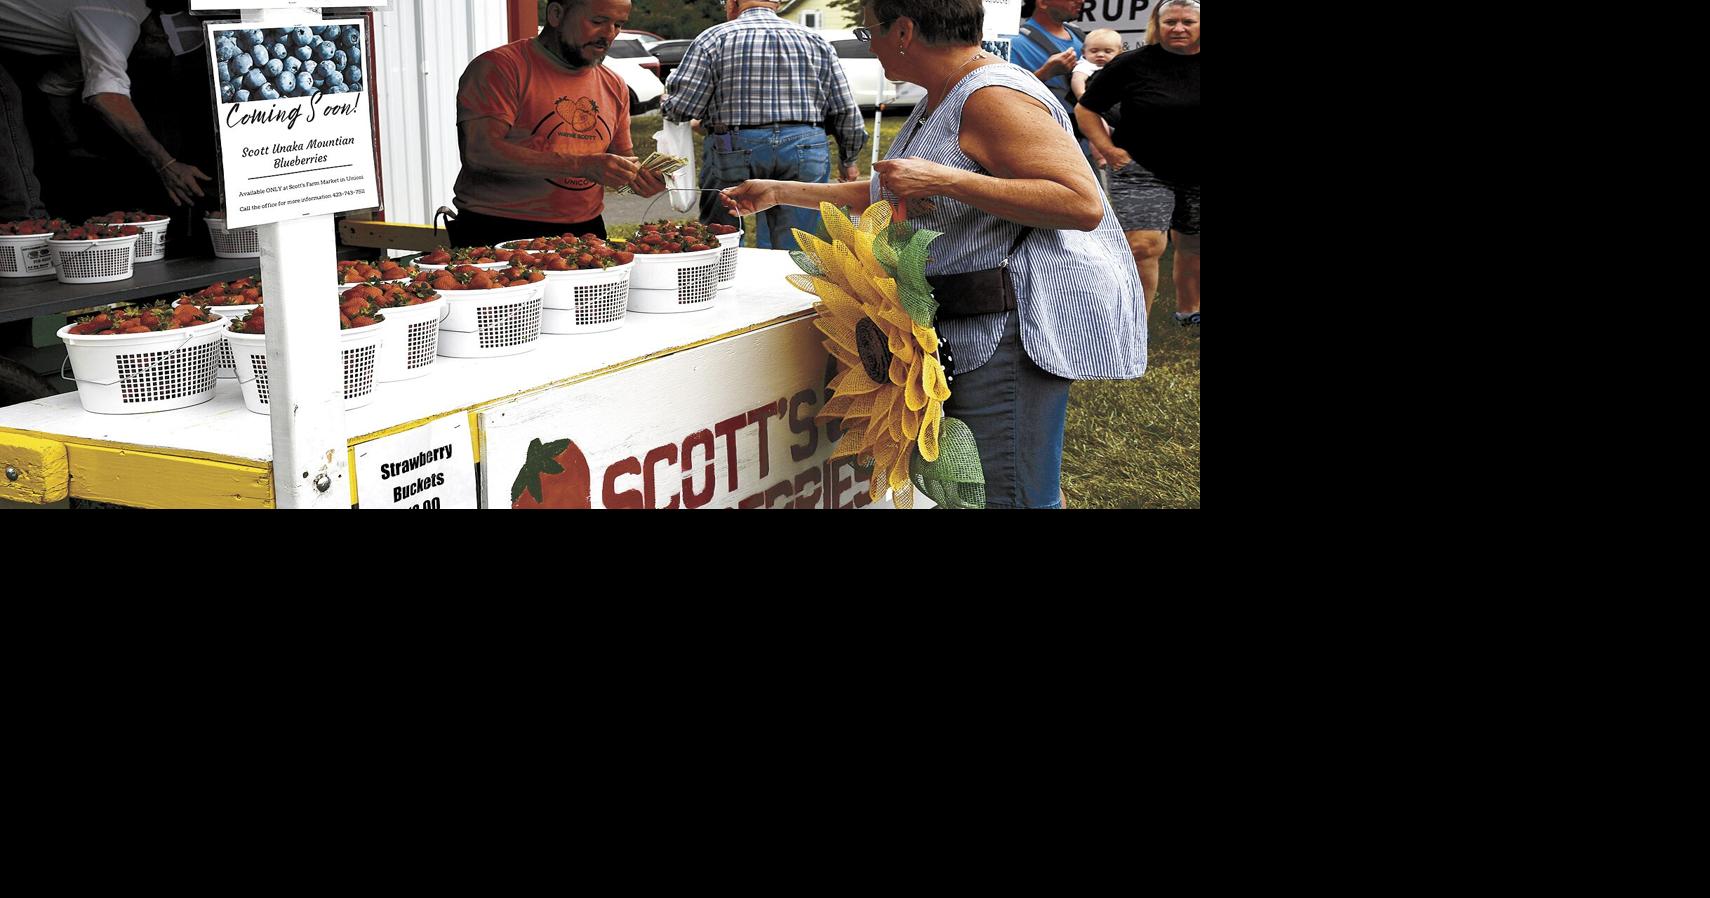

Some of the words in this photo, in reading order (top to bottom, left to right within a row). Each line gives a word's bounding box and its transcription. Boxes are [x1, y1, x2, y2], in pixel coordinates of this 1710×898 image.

[226, 103, 303, 130] Coming
[306, 90, 360, 122] Soon!
[241, 146, 269, 158] Scott
[272, 141, 304, 154] Unaka
[306, 136, 355, 150] Mountian
[273, 154, 328, 169] Blueberries
[239, 188, 265, 197] Available
[289, 182, 305, 190] Scott's
[301, 194, 332, 203] information
[380, 443, 453, 480] Strawberry
[602, 389, 818, 509] SCOTT'S
[393, 472, 445, 503] Buckets
[724, 452, 872, 509] RIES
